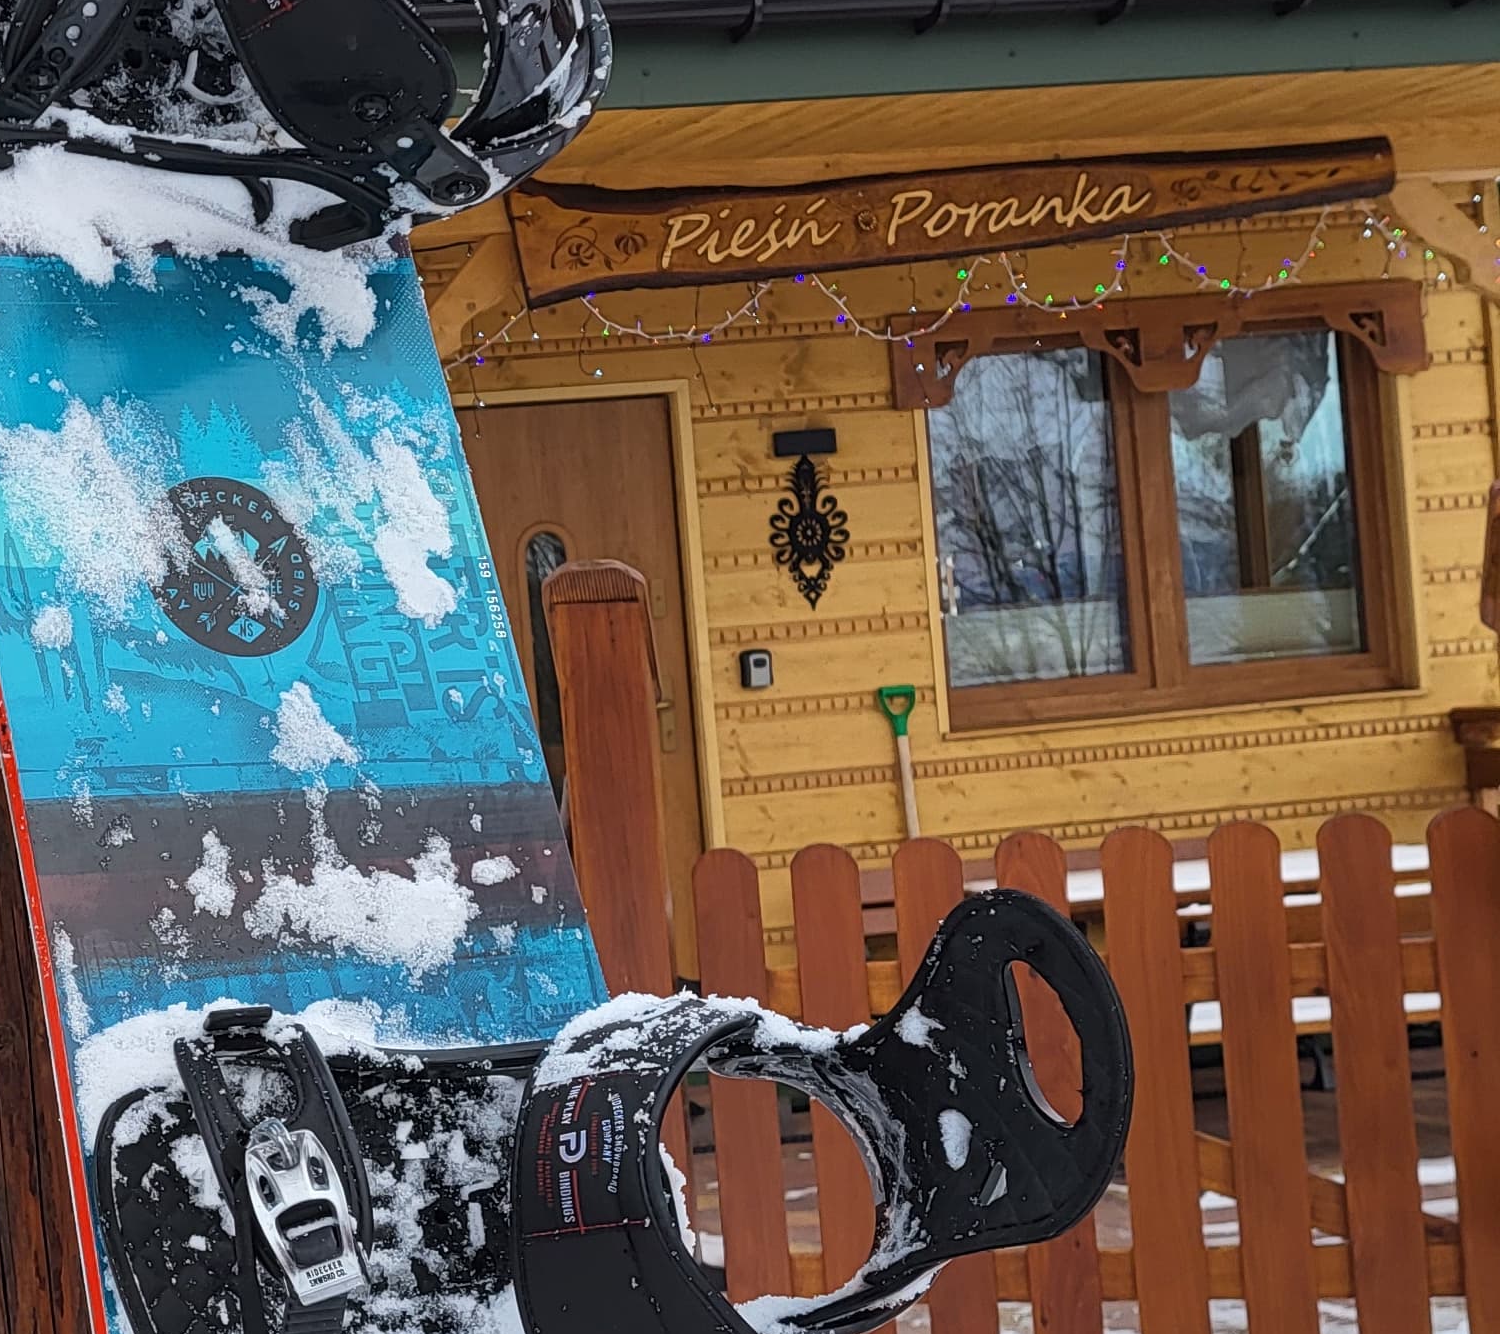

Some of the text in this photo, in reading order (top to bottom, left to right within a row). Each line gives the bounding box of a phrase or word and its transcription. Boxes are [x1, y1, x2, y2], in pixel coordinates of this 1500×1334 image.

[660, 172, 1152, 269] Pieśń Poranka
[477, 555, 507, 639] 159 156258
[561, 1100, 577, 1125] PLAY
[567, 1083, 583, 1100] THE
[601, 1118, 613, 1164] COMPANY
[607, 1134, 625, 1194] SNOWBOARD
[558, 1170, 576, 1224] BINDINGS
[306, 1259, 344, 1279] NIDECKER
